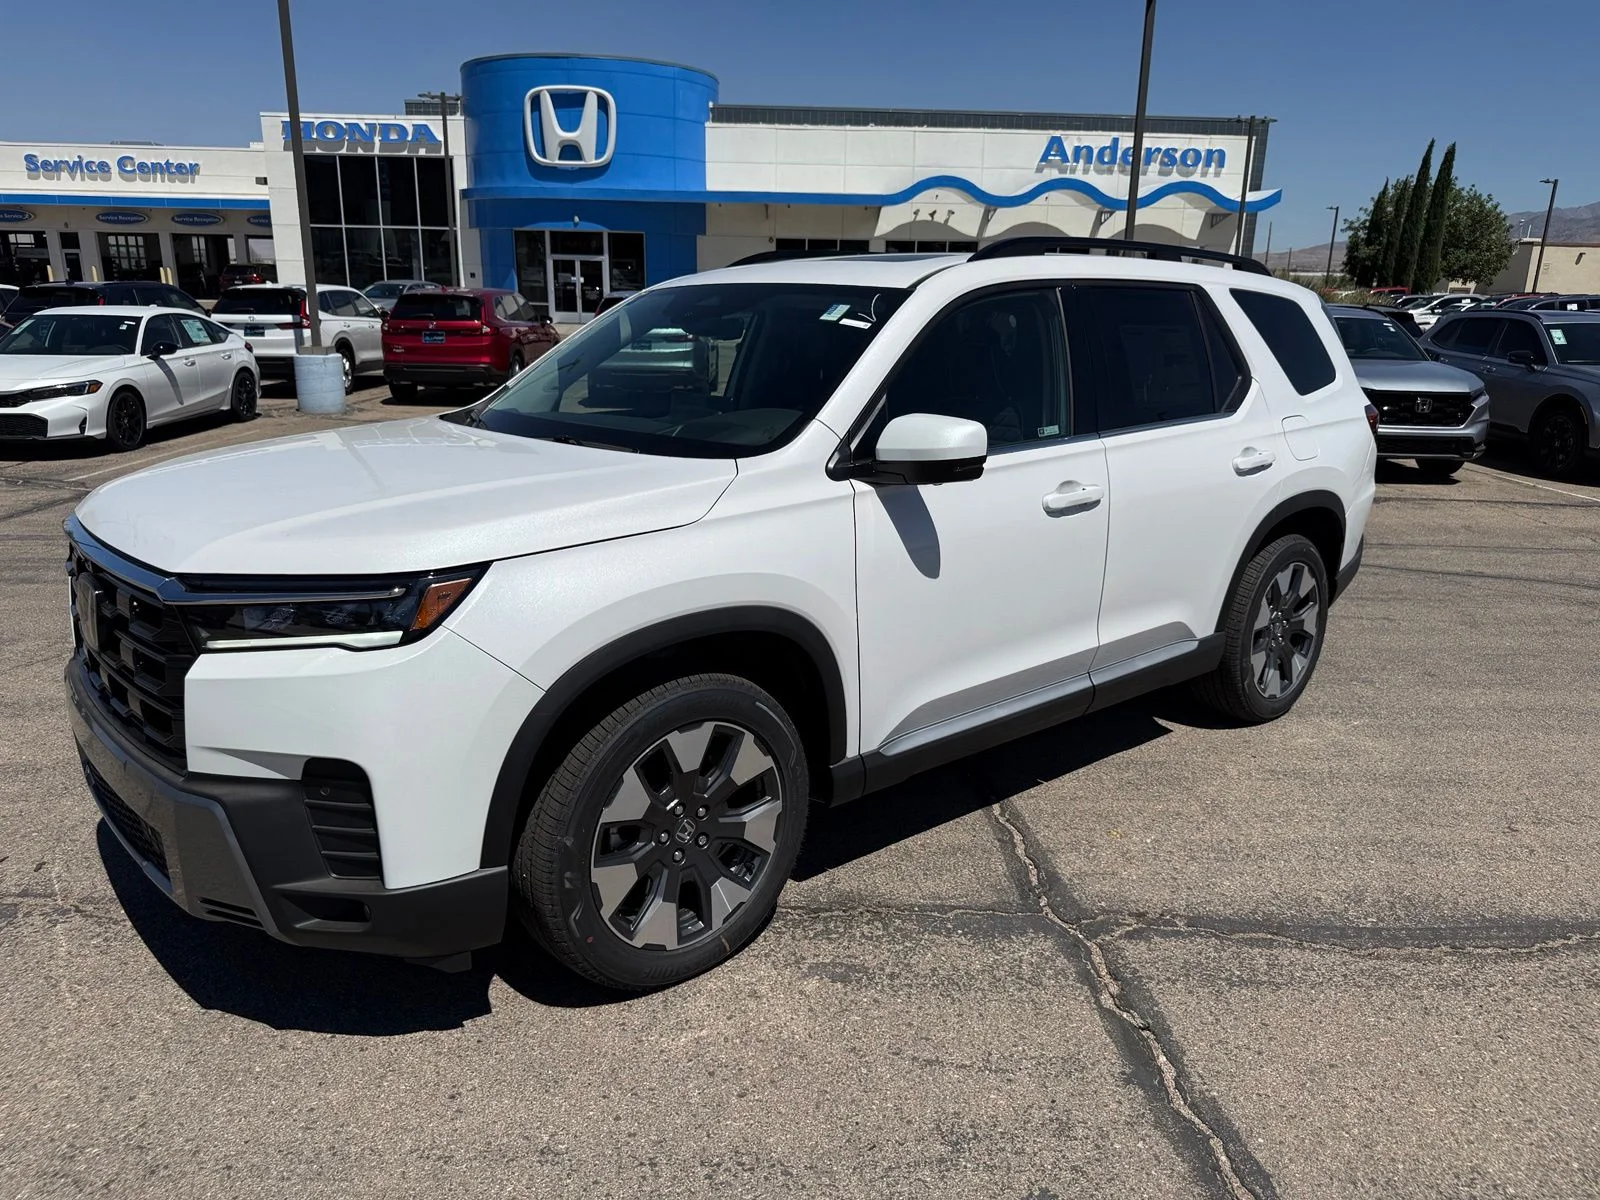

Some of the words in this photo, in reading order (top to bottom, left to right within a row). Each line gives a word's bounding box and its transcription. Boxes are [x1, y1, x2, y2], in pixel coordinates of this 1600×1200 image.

[281, 120, 442, 143] HONDA
[1038, 135, 1226, 169] Anderson
[23, 153, 112, 174] Service
[116, 155, 199, 176] Center
